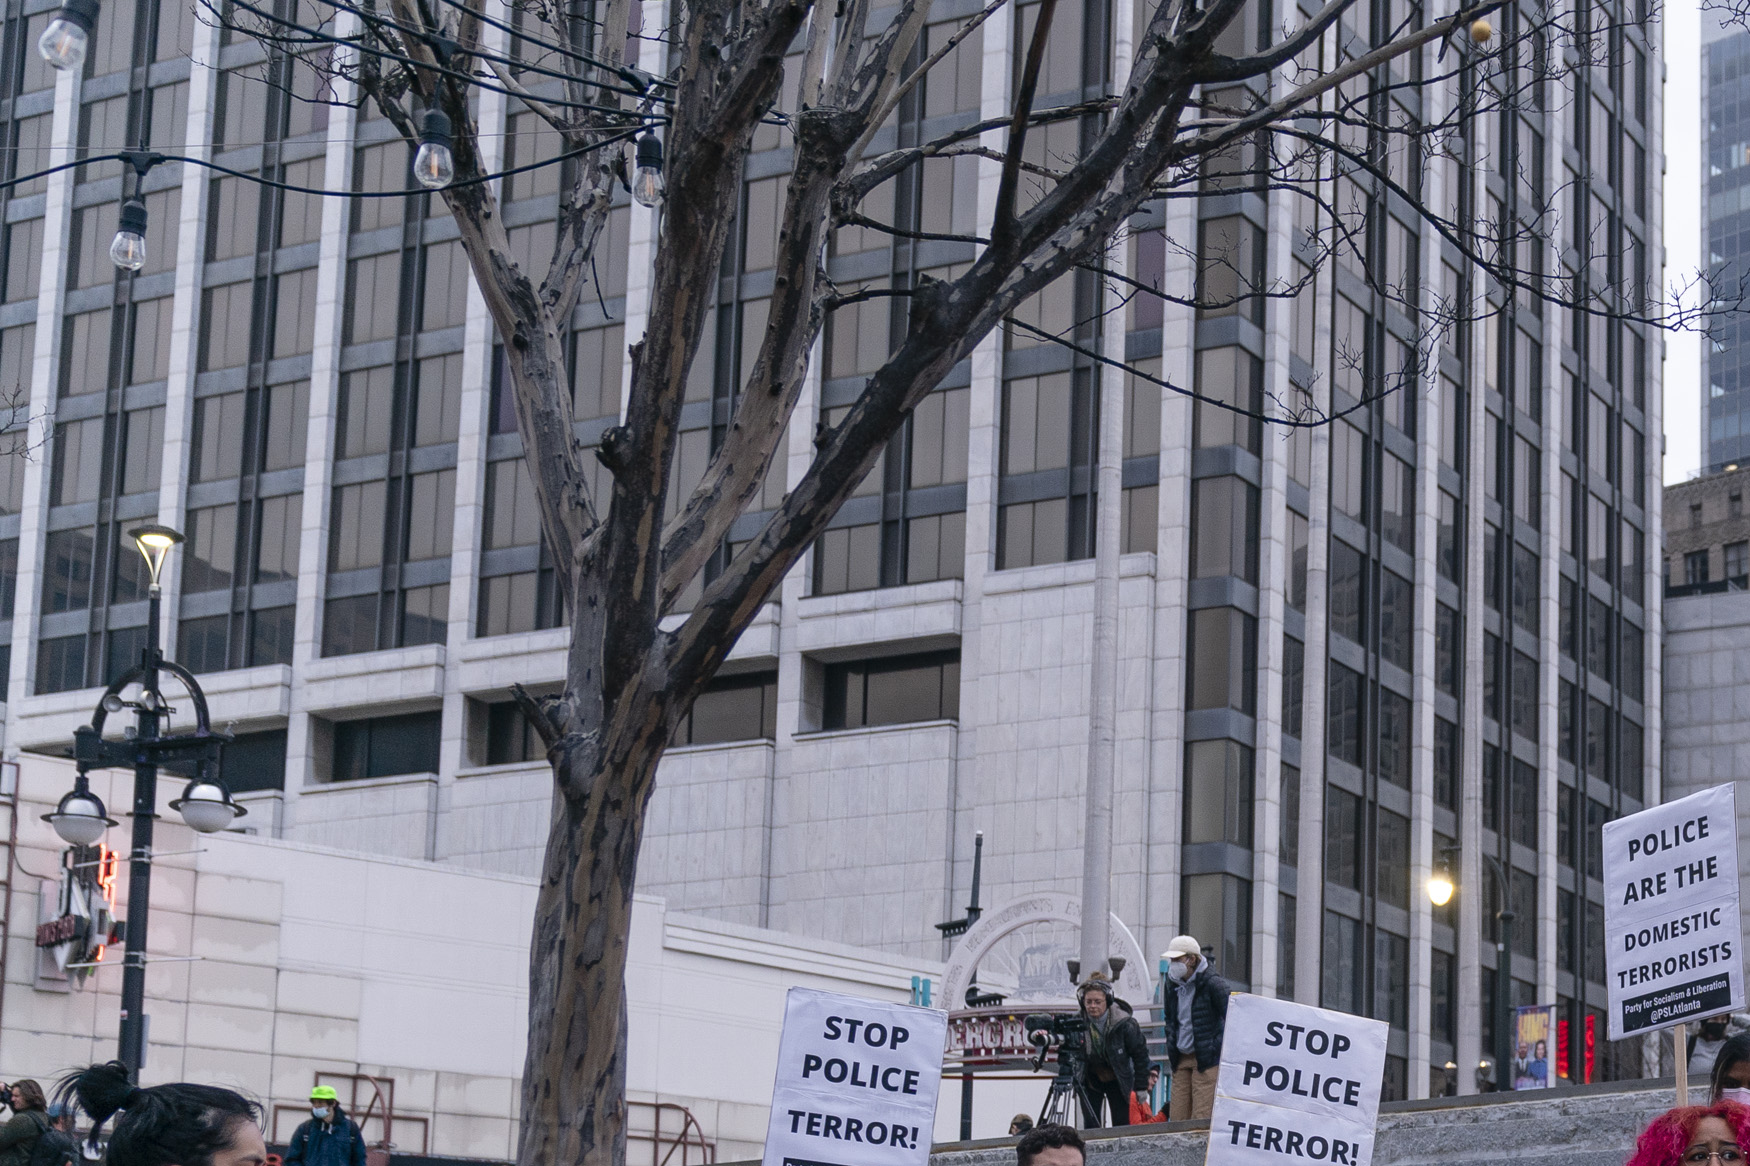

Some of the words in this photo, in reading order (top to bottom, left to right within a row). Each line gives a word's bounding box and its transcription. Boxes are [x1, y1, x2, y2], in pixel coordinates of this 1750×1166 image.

[1628, 816, 1709, 861] POLICE
[1623, 872, 1667, 905] ARE
[1674, 856, 1718, 888] THE
[1625, 908, 1721, 952] DOMESTIC
[1618, 942, 1731, 989] TERRORISTS
[1625, 1003, 1643, 1015] Party
[1643, 999, 1652, 1009] for
[1654, 990, 1685, 1006] Socialism
[1686, 988, 1691, 997] &
[1693, 979, 1727, 995] Liberation
[1650, 1000, 1701, 1023] @PSLAtlanta
[824, 1016, 909, 1050] STOP
[1265, 1021, 1350, 1059] STOP
[802, 1054, 920, 1095] POLICE
[1243, 1060, 1361, 1106] POLICE
[788, 1110, 919, 1149] TERROR!
[1228, 1120, 1359, 1166] TERROR!
